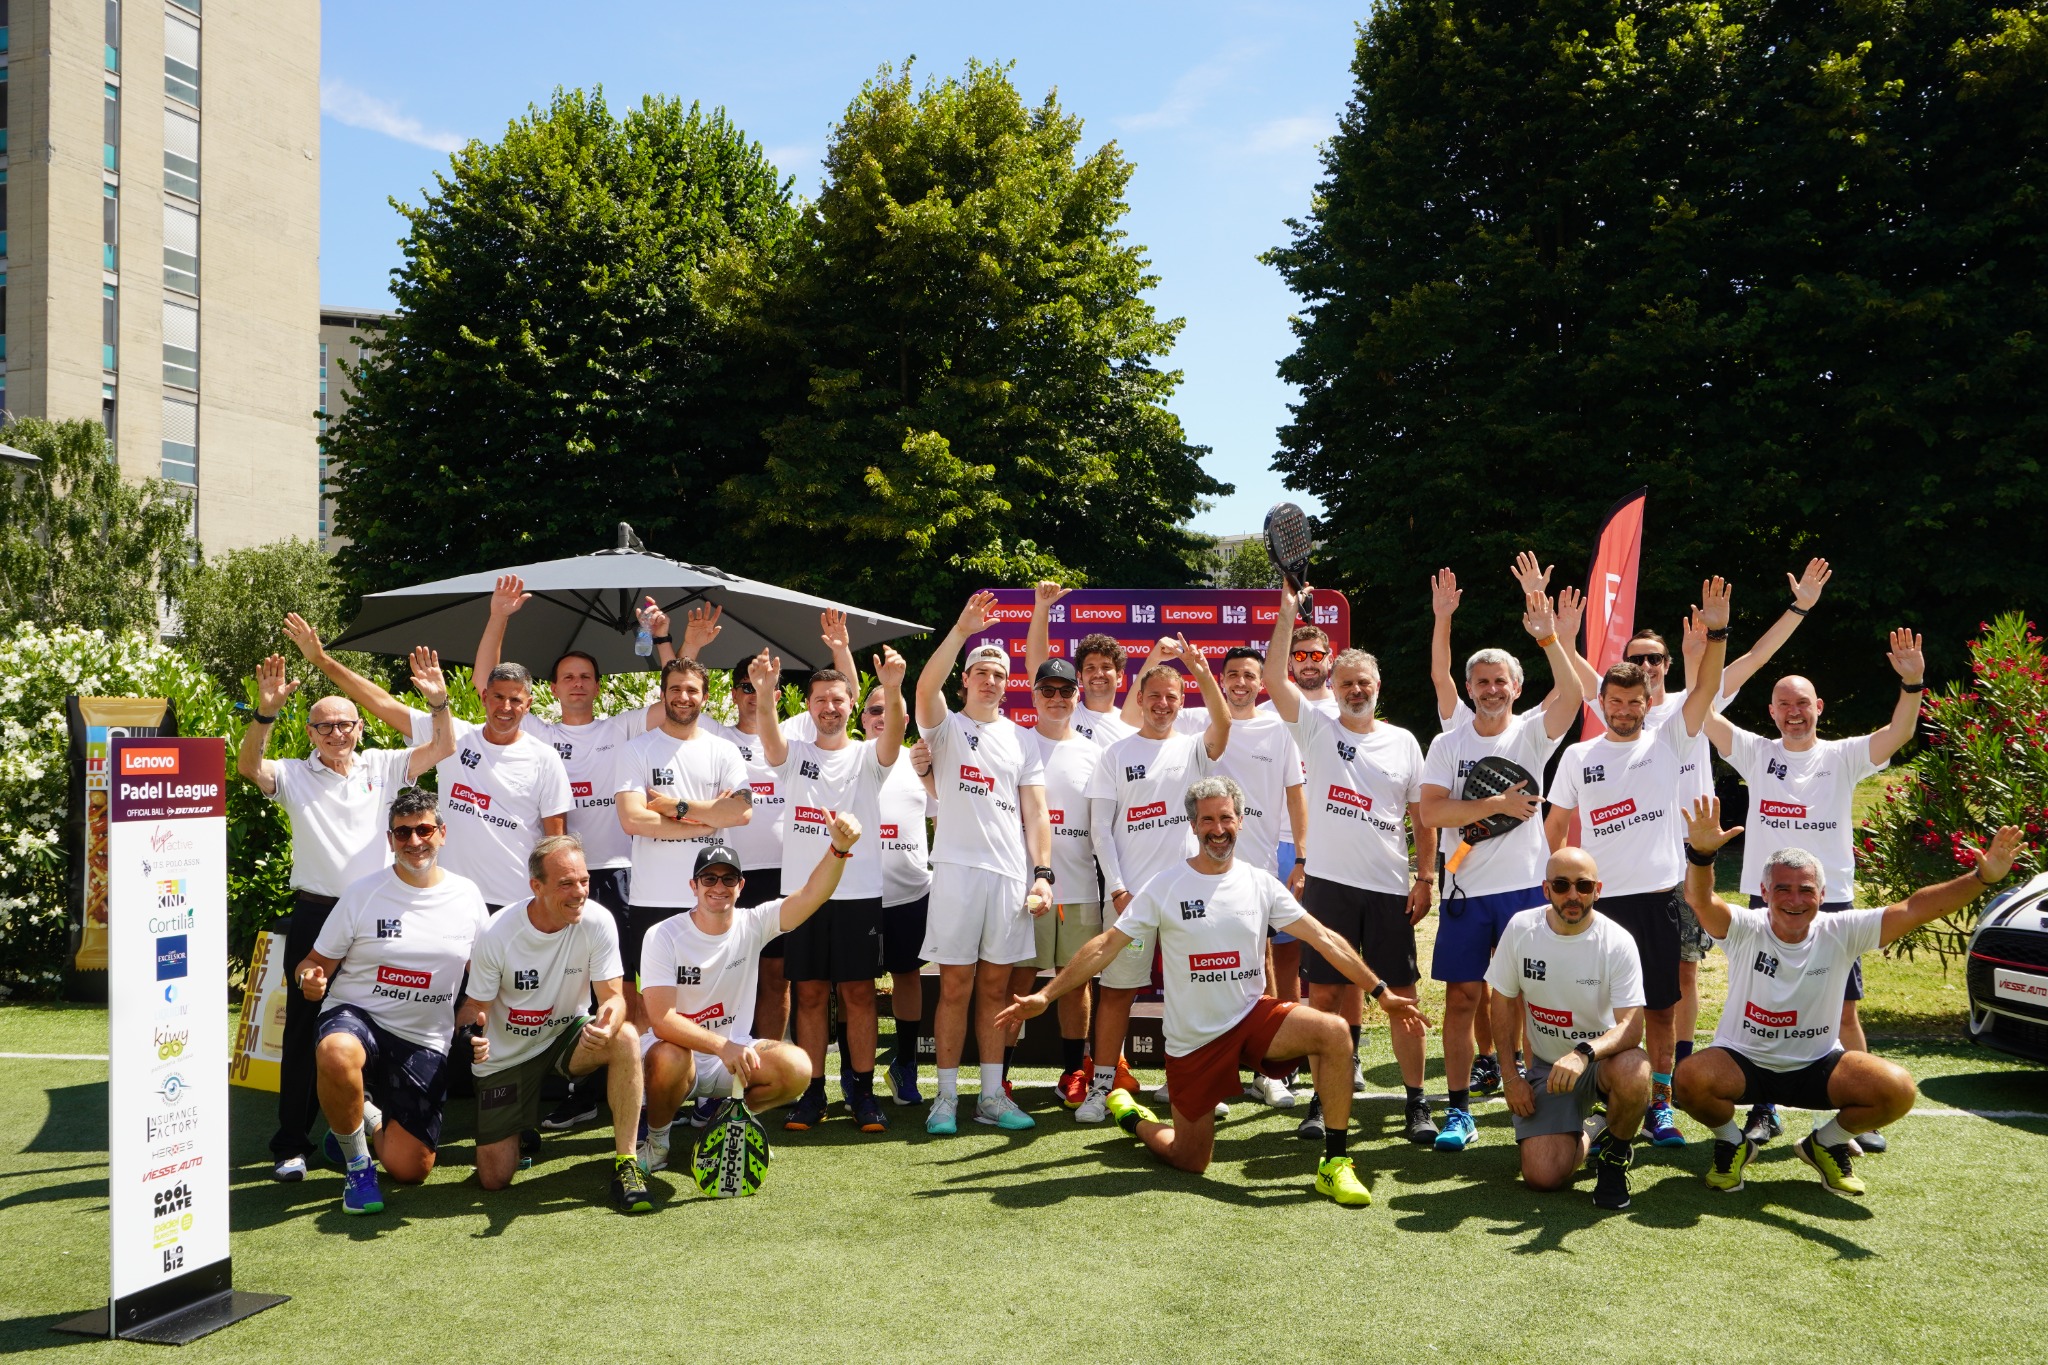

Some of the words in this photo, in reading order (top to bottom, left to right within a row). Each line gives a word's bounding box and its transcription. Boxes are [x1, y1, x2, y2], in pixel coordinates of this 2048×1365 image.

[1075, 608, 1122, 619] Lenovo
[1166, 609, 1213, 620] Lenovo
[1257, 610, 1303, 620] Leno
[1120, 645, 1150, 654] novo
[1015, 711, 1039, 722] Len
[126, 754, 174, 768] Lenovo
[1680, 763, 1695, 774] gue
[121, 782, 162, 800] Padel
[167, 782, 218, 800] League
[454, 786, 486, 806] Lenovo
[959, 782, 988, 796] Padel
[583, 798, 616, 807] Leagu
[1332, 788, 1368, 806] Lenovo
[127, 809, 151, 817] OFFICIAL
[152, 808, 164, 816] BALL
[175, 806, 213, 814] DUNLOP
[449, 800, 475, 815] Padel
[798, 809, 825, 820] Lenov
[1244, 807, 1263, 818] gue
[1326, 803, 1358, 818] Padel
[1592, 803, 1632, 821] Lenovo
[1764, 803, 1802, 814] Lenovo
[793, 824, 820, 835] Padel
[1593, 821, 1626, 837] Padel
[1628, 809, 1665, 826] Leagu
[1795, 820, 1837, 831] League
[1054, 827, 1089, 837] League
[167, 840, 193, 850] active
[166, 860, 182, 868] POLO
[149, 913, 194, 933] Cortilia
[253, 938, 273, 965] SE
[1193, 956, 1236, 967] Lenovo
[247, 966, 268, 995] NZ
[382, 970, 426, 985] Lenovo
[1190, 971, 1226, 982] Padel
[372, 985, 411, 1001] Padel
[414, 992, 453, 1004] League
[241, 995, 261, 1023] AT
[693, 1008, 719, 1023] novo
[1750, 1005, 1792, 1023] Lenovo
[506, 1023, 541, 1037] Padel
[1562, 1029, 1608, 1040] Leagu
[1743, 1020, 1779, 1038] Padel
[1784, 1025, 1829, 1039] League
[236, 1024, 260, 1052] EM
[231, 1052, 250, 1081] PO
[721, 1125, 744, 1196] Babolat
[154, 1196, 192, 1218] MATE
